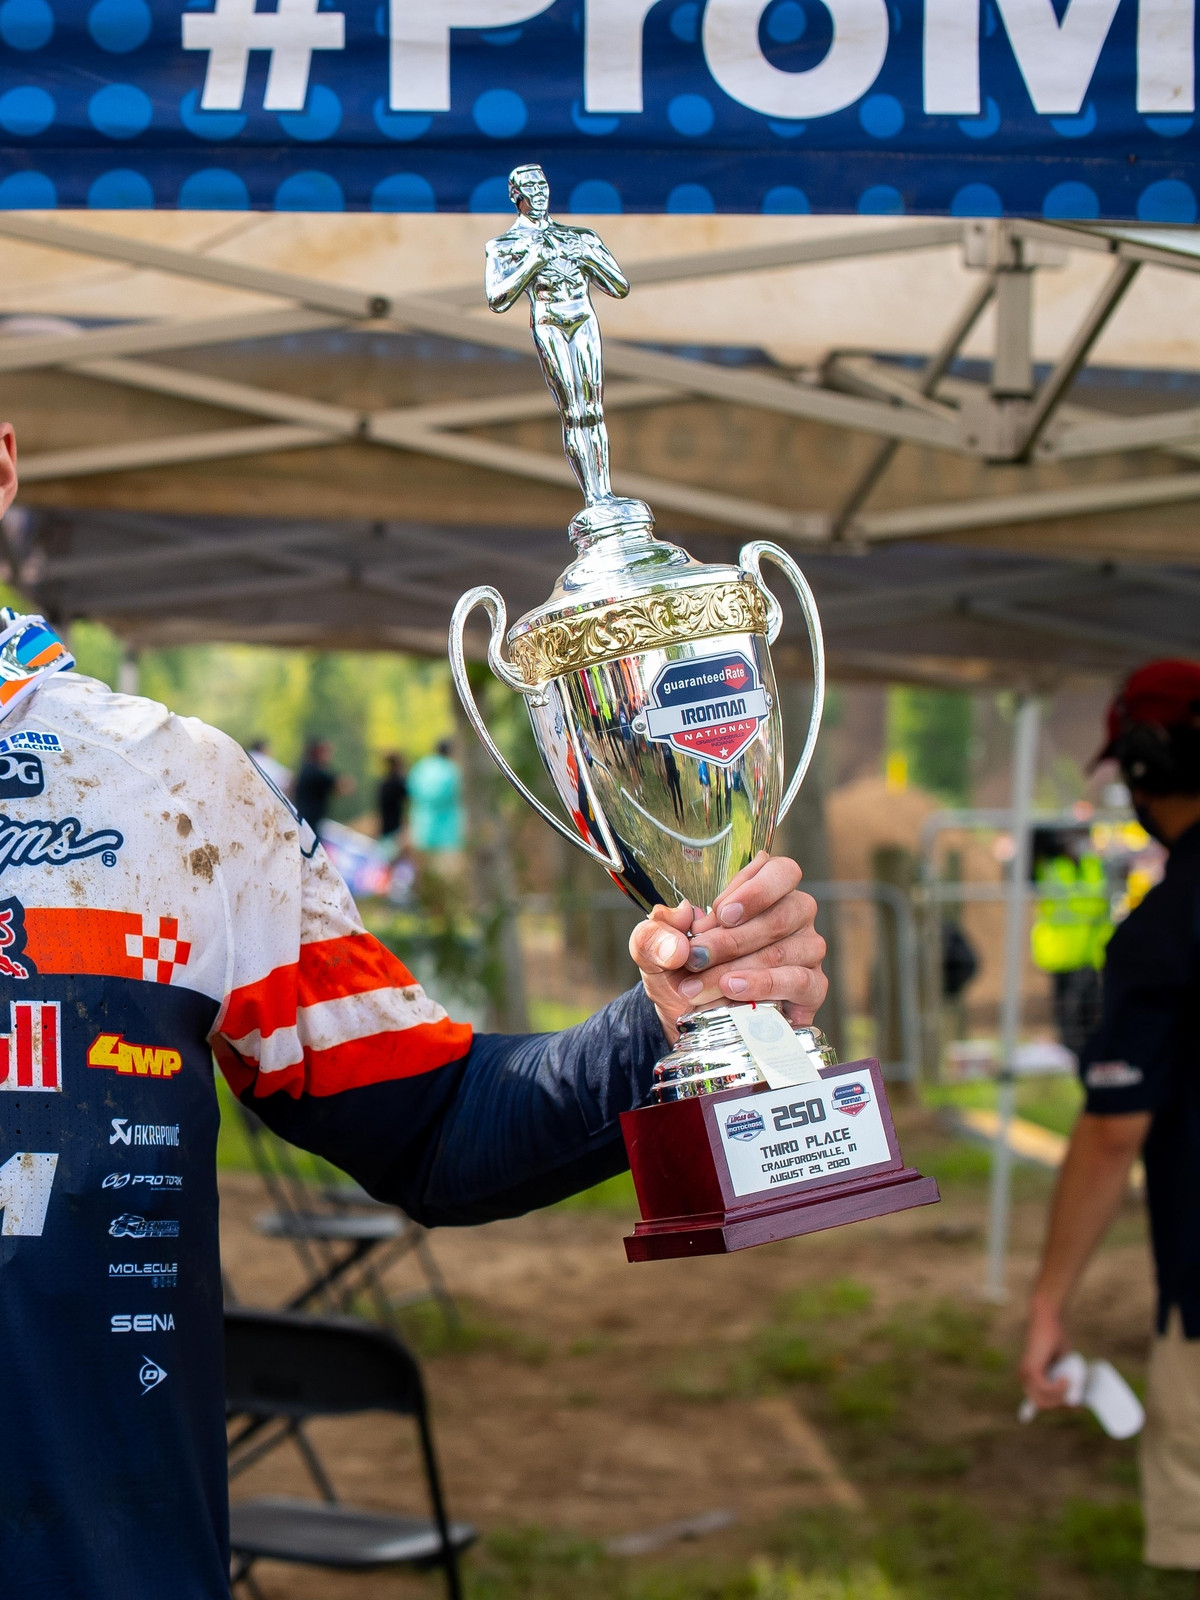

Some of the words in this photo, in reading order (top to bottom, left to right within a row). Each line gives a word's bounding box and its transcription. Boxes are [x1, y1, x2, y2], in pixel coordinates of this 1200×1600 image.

[680, 698, 747, 725] IRONMAN
[9, 731, 60, 746] PRO
[684, 722, 752, 741] NATIONAL
[13, 743, 62, 752] RACING
[711, 739, 734, 748] INDIANA
[771, 1097, 827, 1132] 250
[760, 1139, 799, 1159] THIRD
[805, 1127, 851, 1149] PLACE
[761, 1146, 844, 1173] CRAWFORDSVILLE,
[848, 1142, 857, 1153] IN
[769, 1168, 804, 1184] AUGUST
[808, 1164, 824, 1175] 29,
[826, 1157, 851, 1170] 2020
[131, 1175, 163, 1186] PRO
[108, 1263, 178, 1274] MOLECULE
[110, 1313, 175, 1333] SENA
